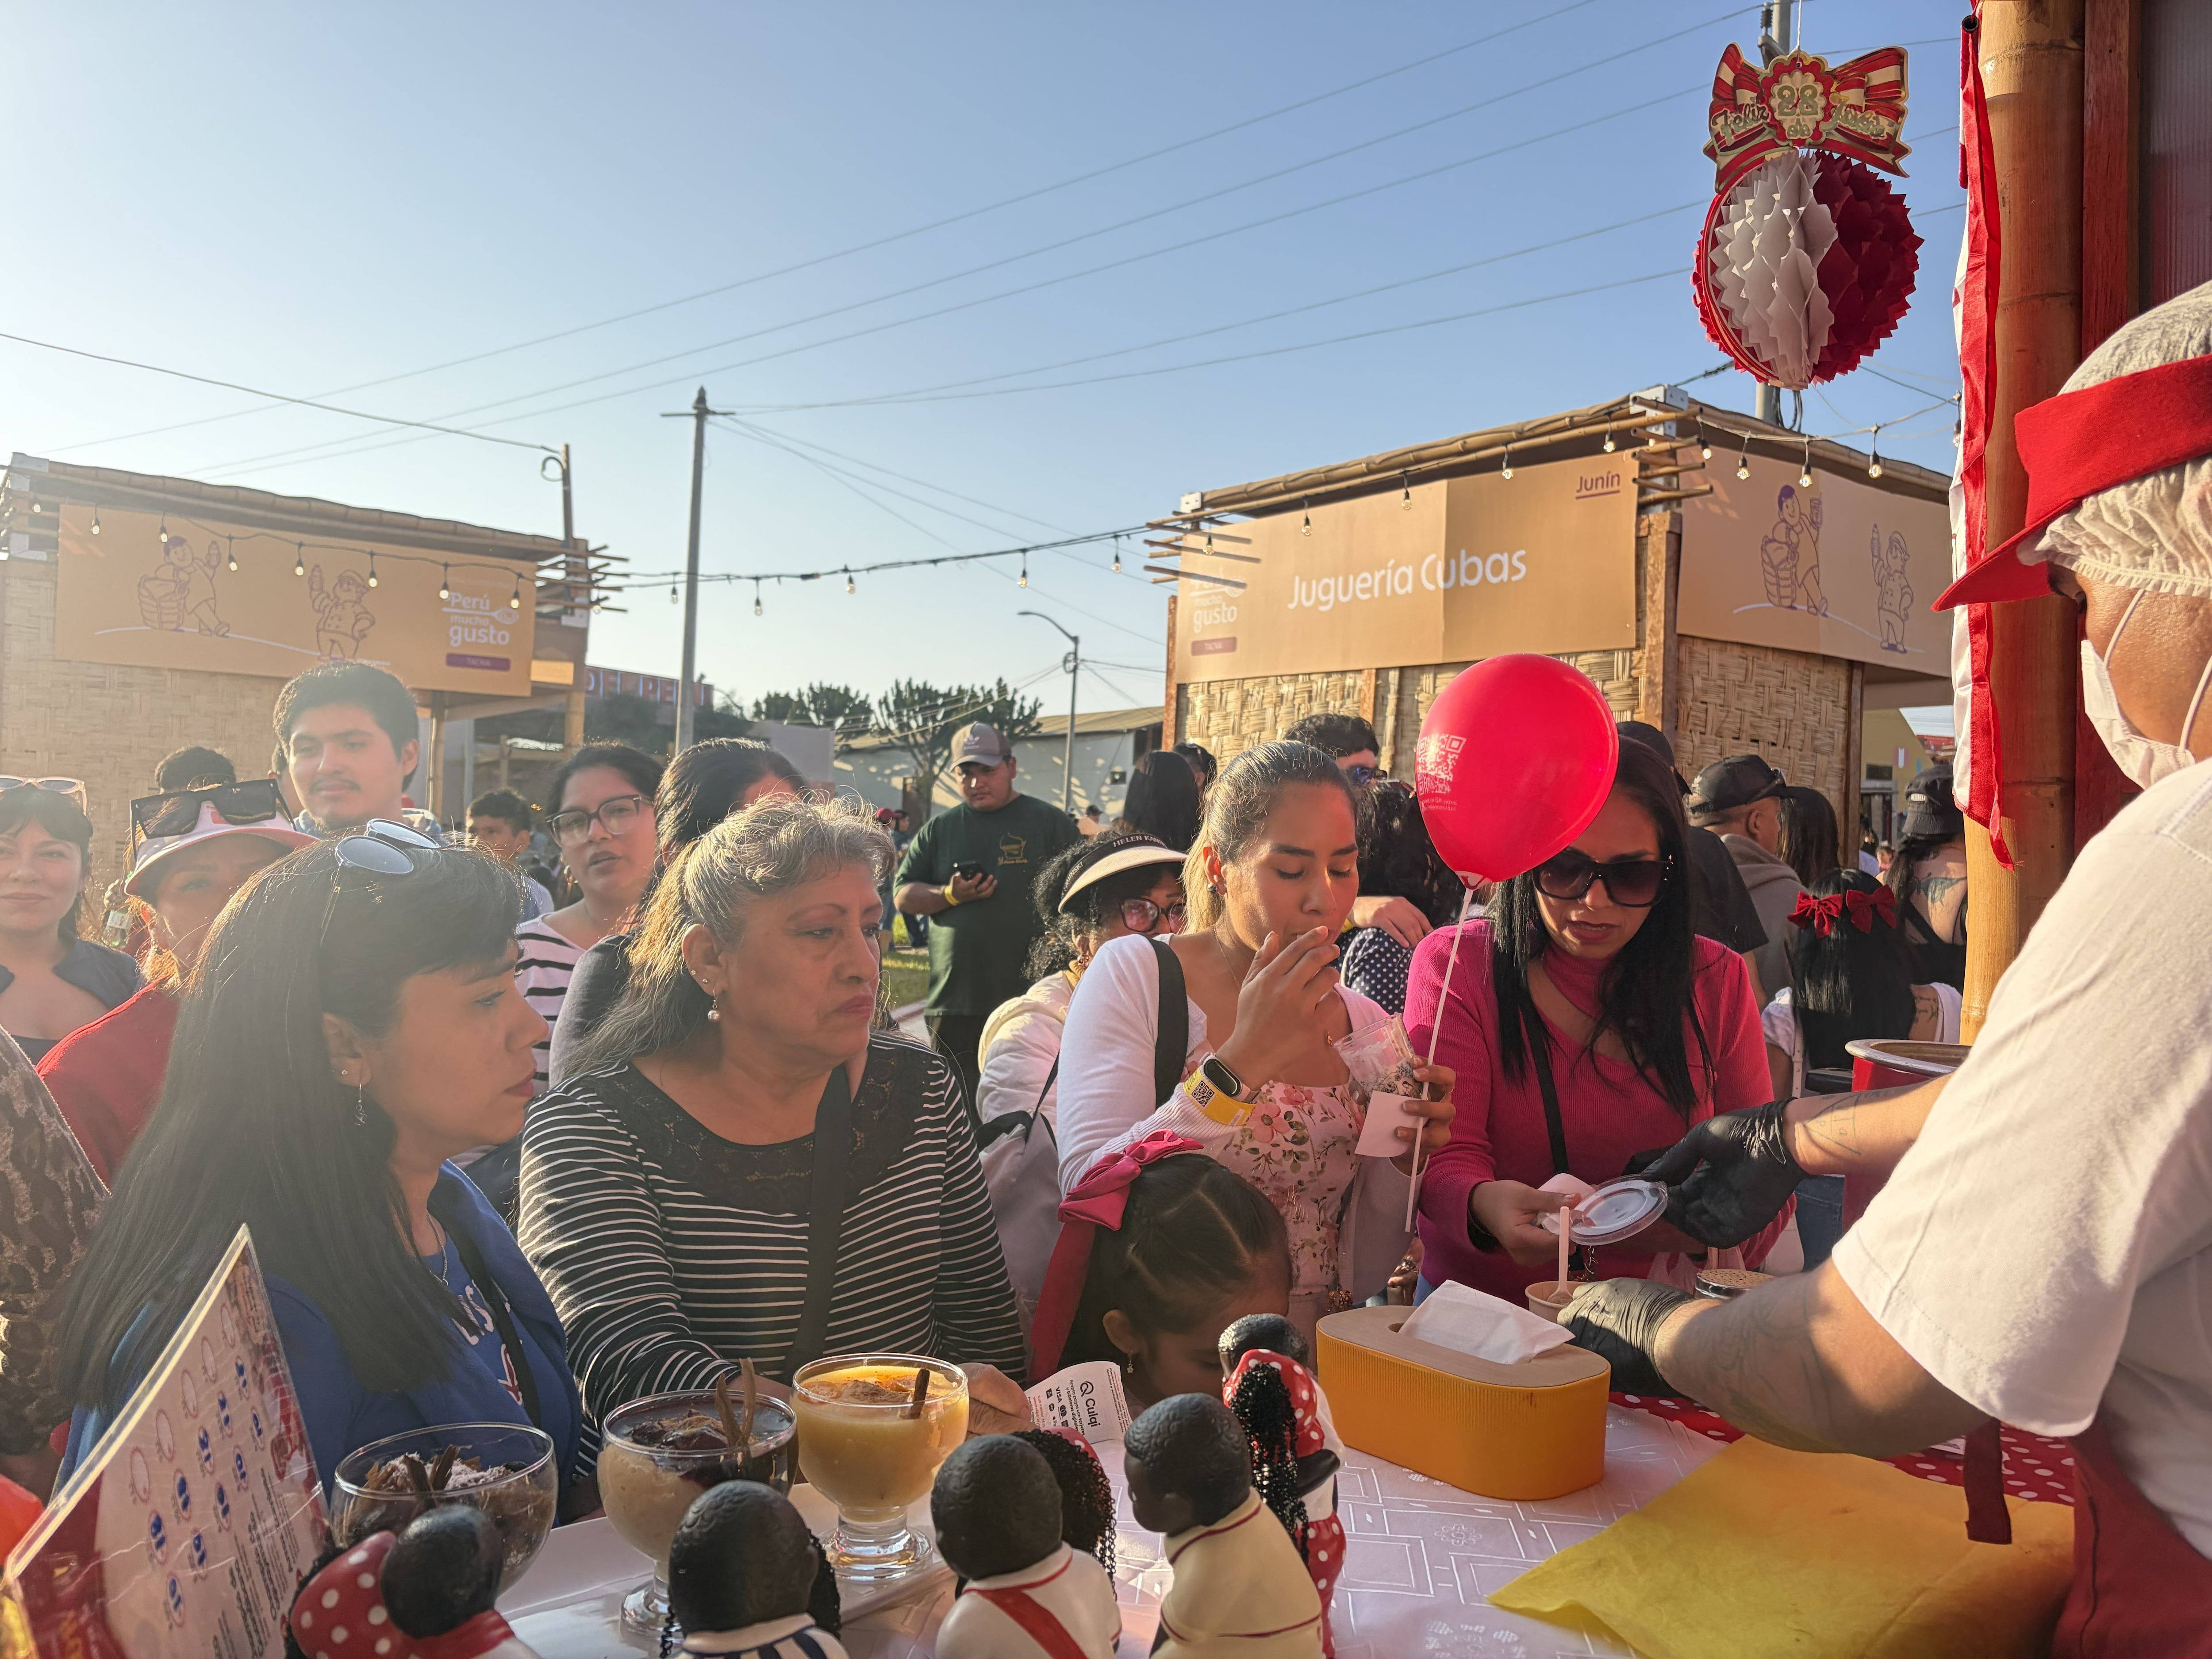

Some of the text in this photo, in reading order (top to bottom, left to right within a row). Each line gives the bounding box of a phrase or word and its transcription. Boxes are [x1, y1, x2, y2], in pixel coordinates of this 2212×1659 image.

[1778, 85, 1818, 116] 28
[1712, 101, 1769, 146] Feliz
[1787, 119, 1810, 137] de
[1576, 470, 1621, 493] Junín
[1287, 549, 1528, 612] Juguería Cubas
[447, 592, 490, 611] Perú
[450, 615, 489, 626] mucho
[1193, 602, 1238, 634] gusto
[449, 625, 510, 647] gusto
[1113, 835, 1142, 848] HELEN
[1085, 1398, 1101, 1427] Culqi
[236, 1454, 246, 1479] 10
[171, 1580, 181, 1608] 10
